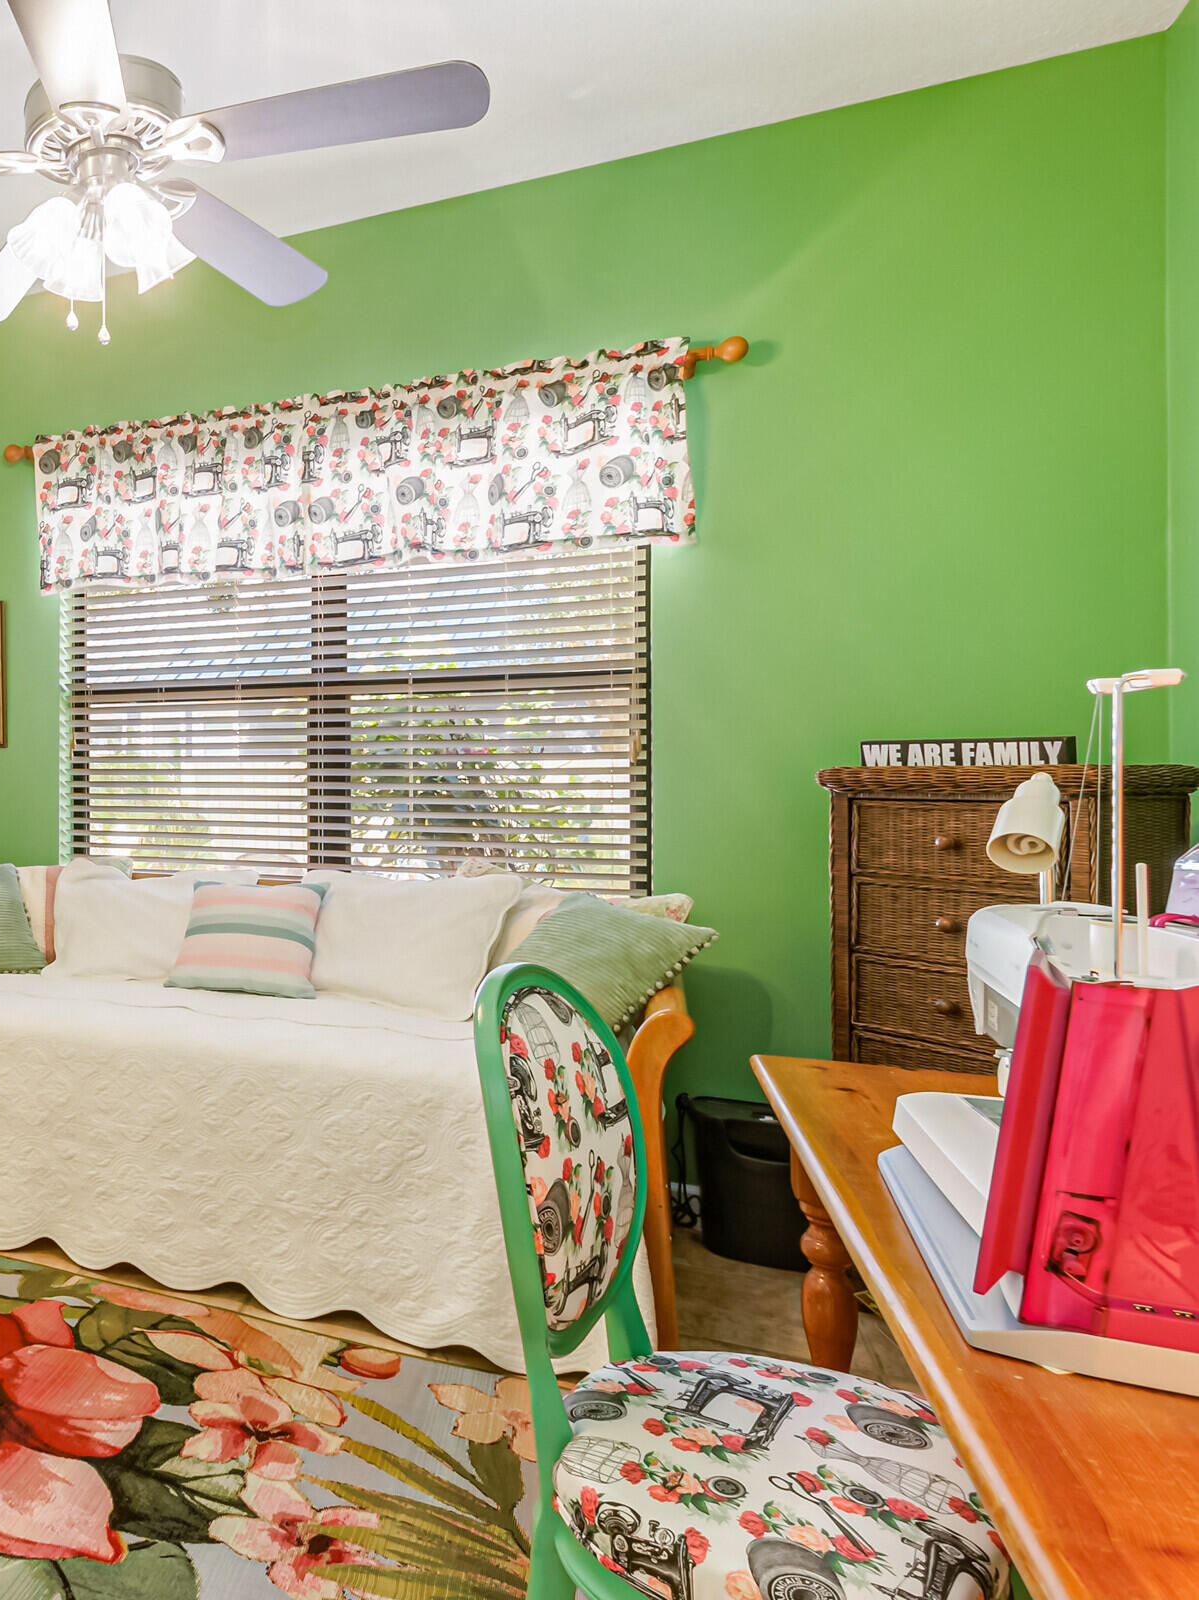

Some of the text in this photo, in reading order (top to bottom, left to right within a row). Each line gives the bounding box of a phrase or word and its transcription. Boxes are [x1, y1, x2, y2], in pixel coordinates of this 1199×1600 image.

[862, 741, 1063, 767] WE ARE FAMILY
